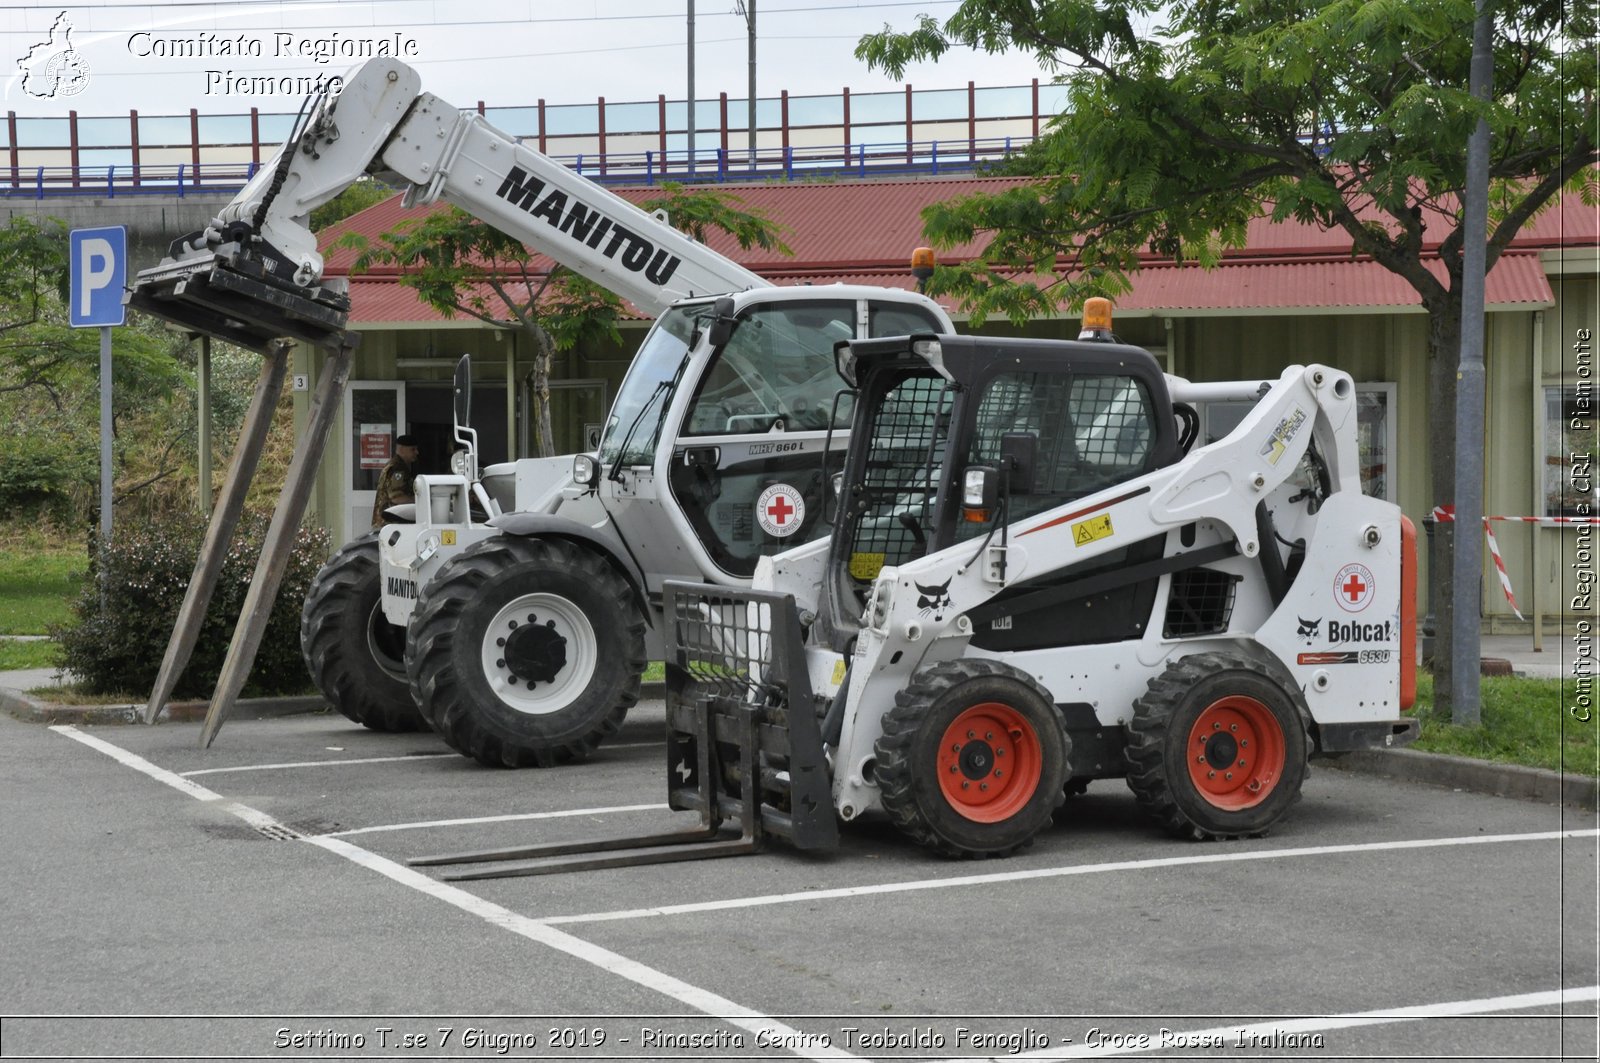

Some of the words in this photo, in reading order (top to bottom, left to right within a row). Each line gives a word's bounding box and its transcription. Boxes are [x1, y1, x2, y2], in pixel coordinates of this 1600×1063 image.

[496, 165, 682, 286] MANITOU
[80, 238, 115, 317] P
[297, 377, 304, 388] 3
[749, 443, 775, 455] MHT
[776, 442, 797, 453] 860
[799, 441, 804, 450] L
[1328, 620, 1391, 643] Bobcat
[1359, 650, 1391, 664] S530
